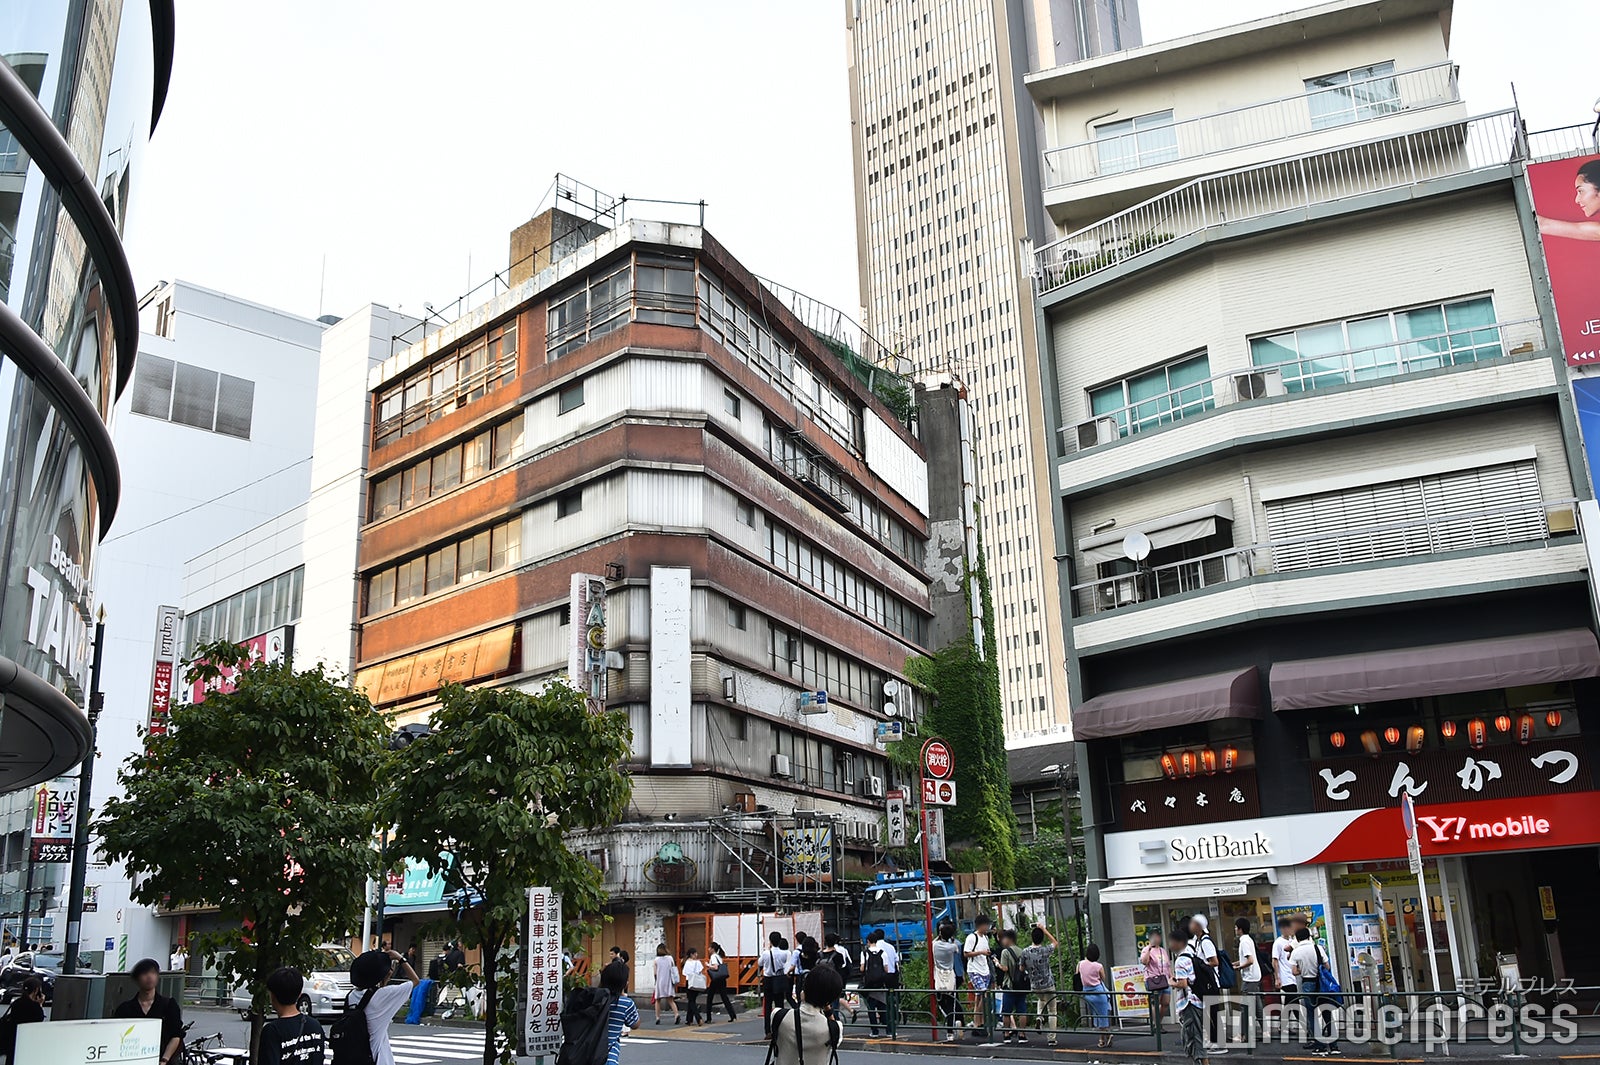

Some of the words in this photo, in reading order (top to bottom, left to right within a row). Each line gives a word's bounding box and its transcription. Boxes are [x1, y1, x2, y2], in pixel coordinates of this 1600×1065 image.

[928, 753, 948, 769] 消火栓
[1318, 750, 1579, 800] とんかつ
[48, 790, 61, 833] スロット
[60, 790, 77, 833] パチンコ
[1130, 787, 1246, 813] 代々木庵
[39, 852, 69, 861] アクアス
[42, 844, 66, 853] 代々木
[1170, 832, 1271, 862] SoftBank
[529, 893, 545, 1034] 自転車は車道寄りを
[546, 893, 560, 1033] 歩道は歩行者が優先
[86, 1045, 108, 1060] 3F
